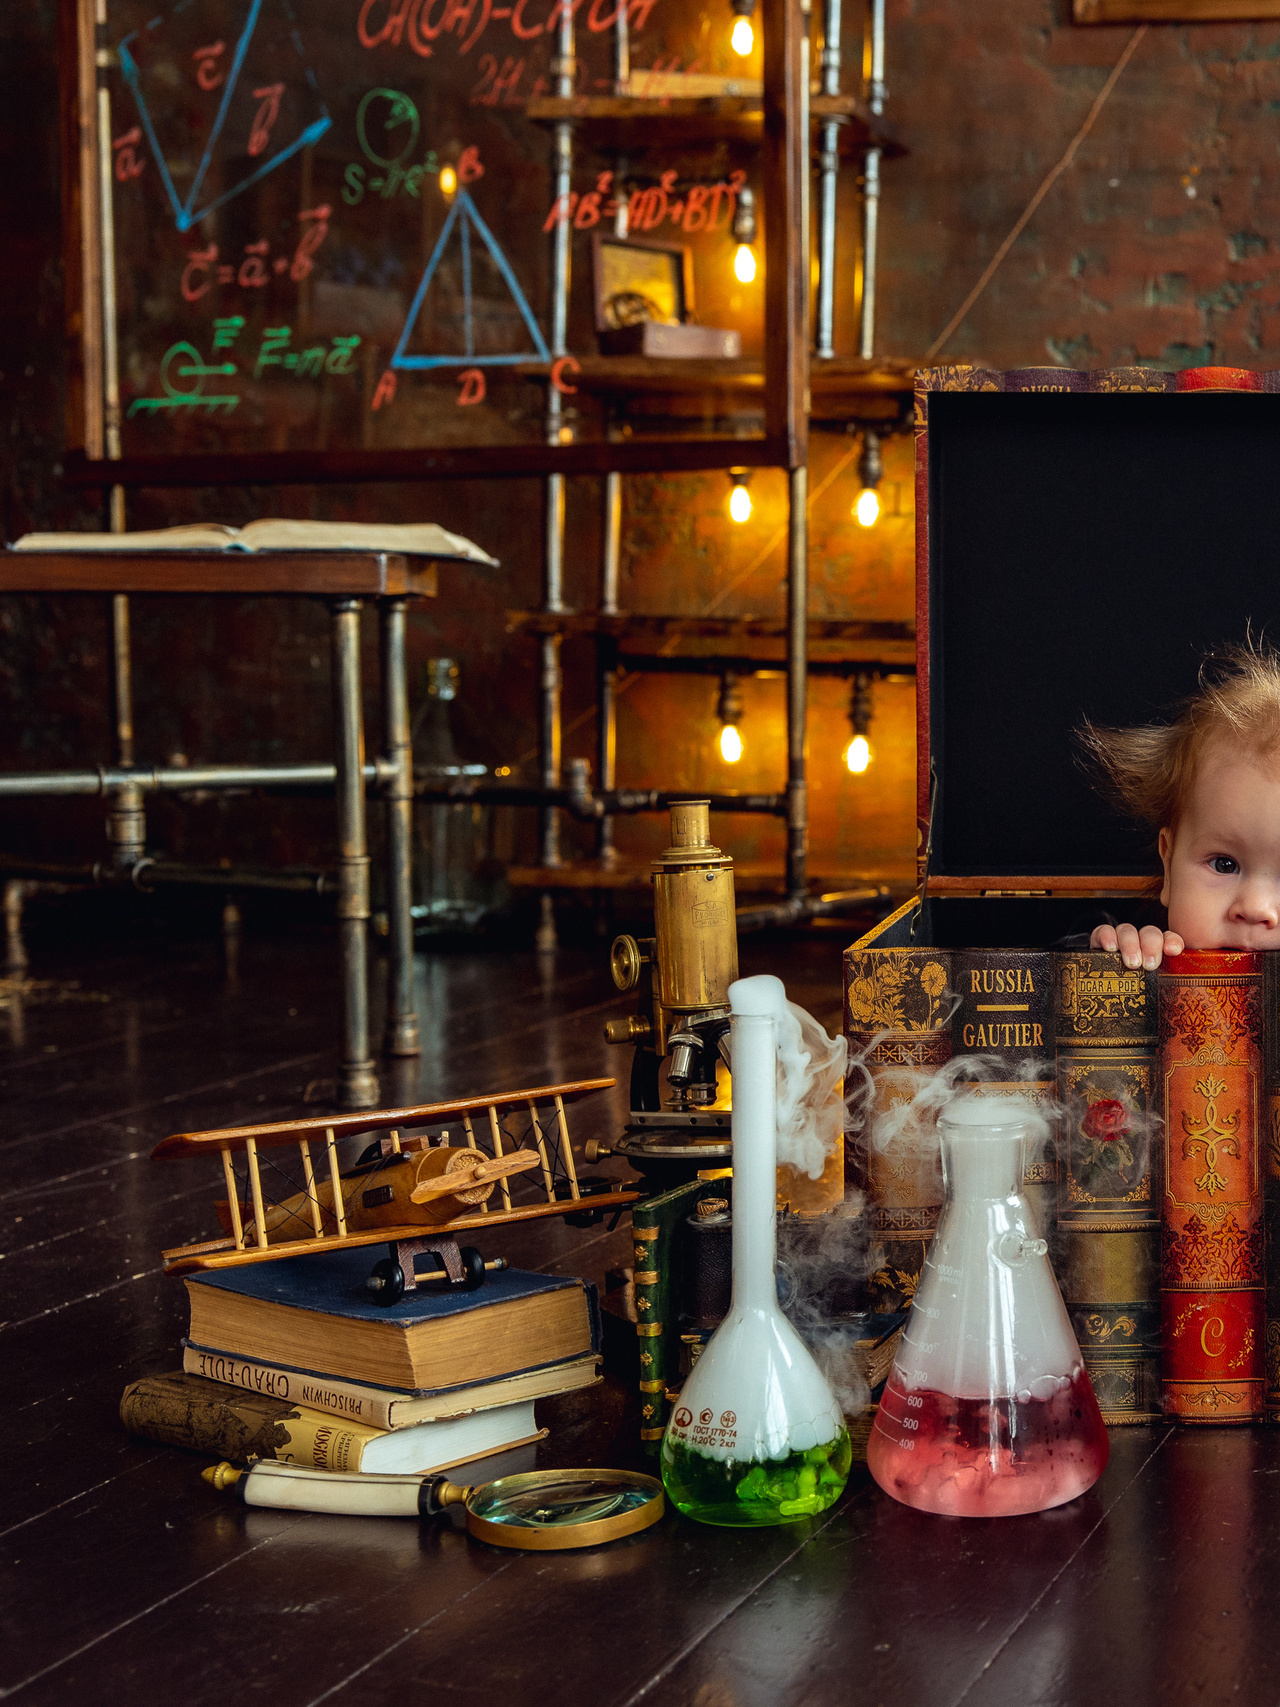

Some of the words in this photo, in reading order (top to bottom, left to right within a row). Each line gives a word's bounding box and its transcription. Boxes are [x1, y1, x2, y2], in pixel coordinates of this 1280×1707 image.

[970, 969, 1035, 994] RUSSIA
[962, 1023, 1043, 1048] GAUTIER
[926, 1308, 940, 1320] 900
[919, 1342, 933, 1354] 800
[198, 1354, 289, 1398] GRAU-EULE
[913, 1371, 928, 1383] 700
[302, 1384, 363, 1415] PRISCHWIN
[907, 1395, 923, 1408] 600
[902, 1417, 919, 1430] 500
[693, 1424, 710, 1435] ГОСТ
[710, 1427, 737, 1438] 1770-74
[898, 1438, 915, 1451] 400
